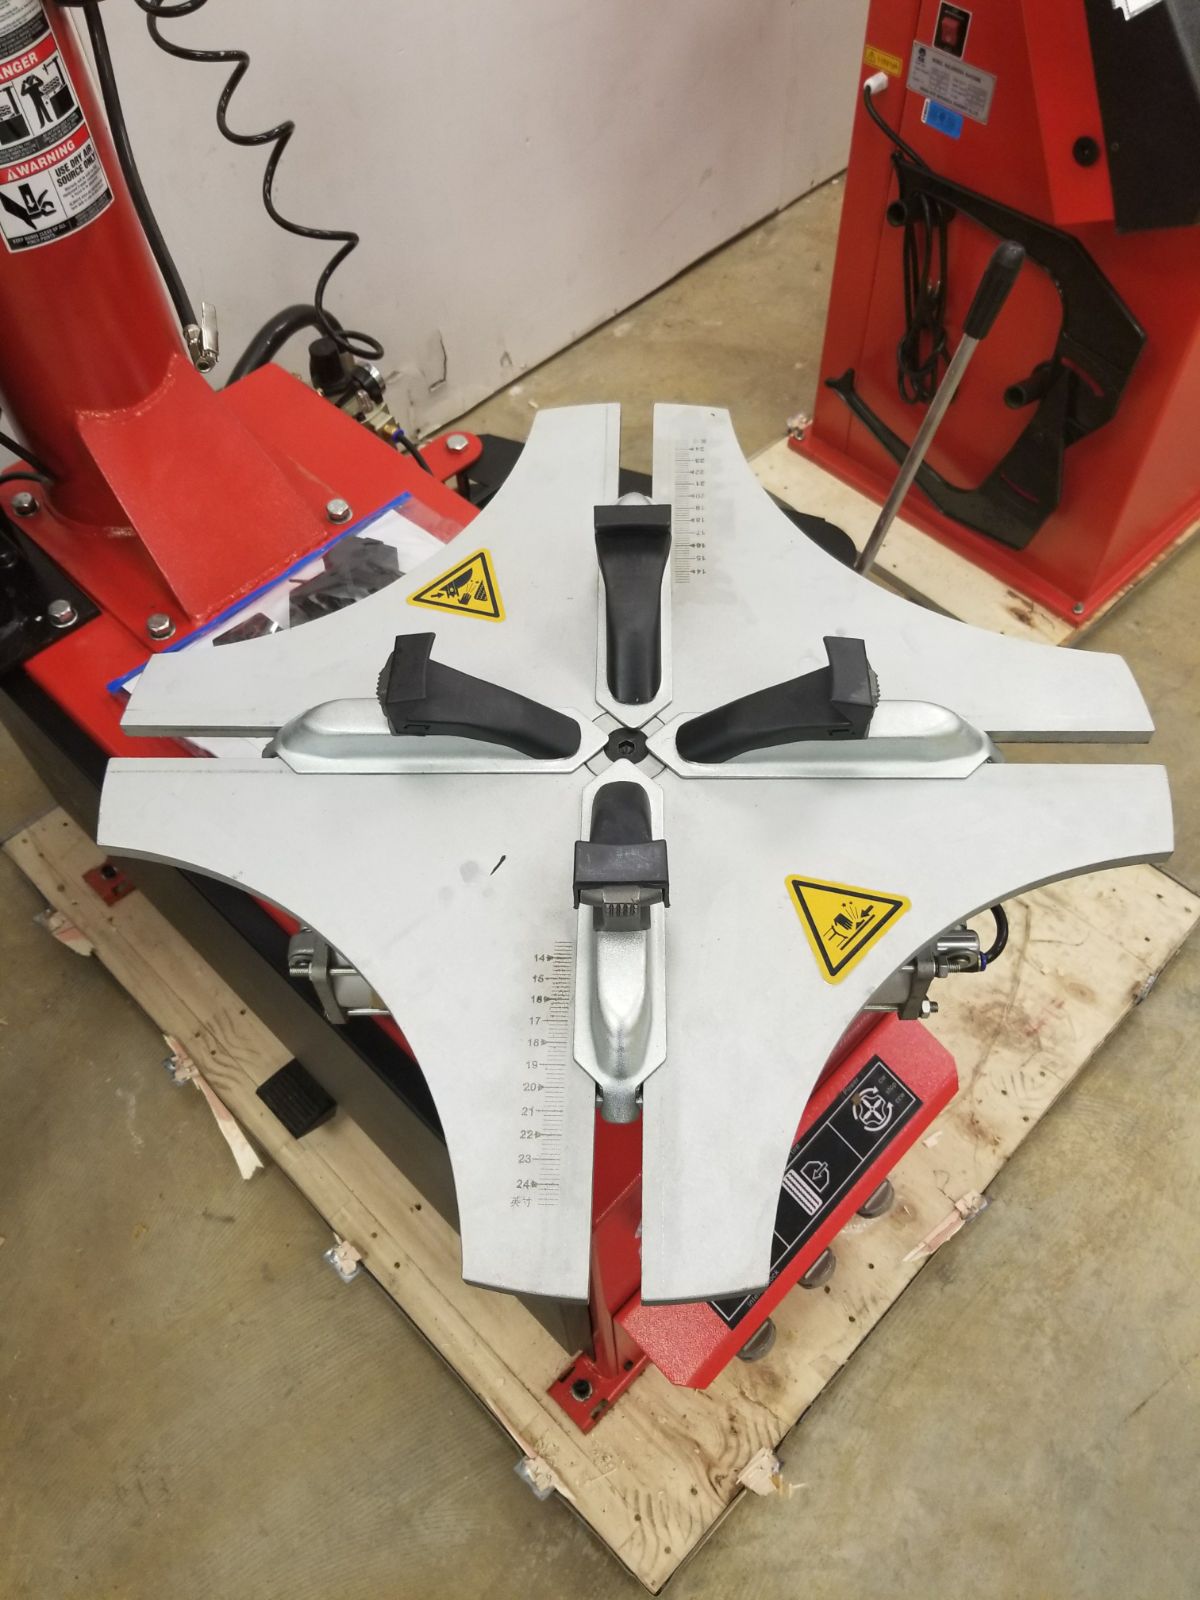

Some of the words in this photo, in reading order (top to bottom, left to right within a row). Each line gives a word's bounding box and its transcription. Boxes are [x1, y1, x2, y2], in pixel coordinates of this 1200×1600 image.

[16, 140, 75, 177] WARNING
[55, 163, 70, 177] USE
[70, 153, 82, 168] DRY
[57, 164, 84, 187] SOURCE
[83, 152, 96, 169] ONLY
[534, 954, 545, 962] 14
[532, 974, 544, 983] 15
[529, 1016, 541, 1025] 17
[526, 1061, 538, 1069] 19
[522, 1082, 536, 1092] 20
[521, 1106, 534, 1116] 21
[520, 1130, 533, 1139] 22
[518, 1154, 531, 1164] 23
[516, 1179, 530, 1189] 24
